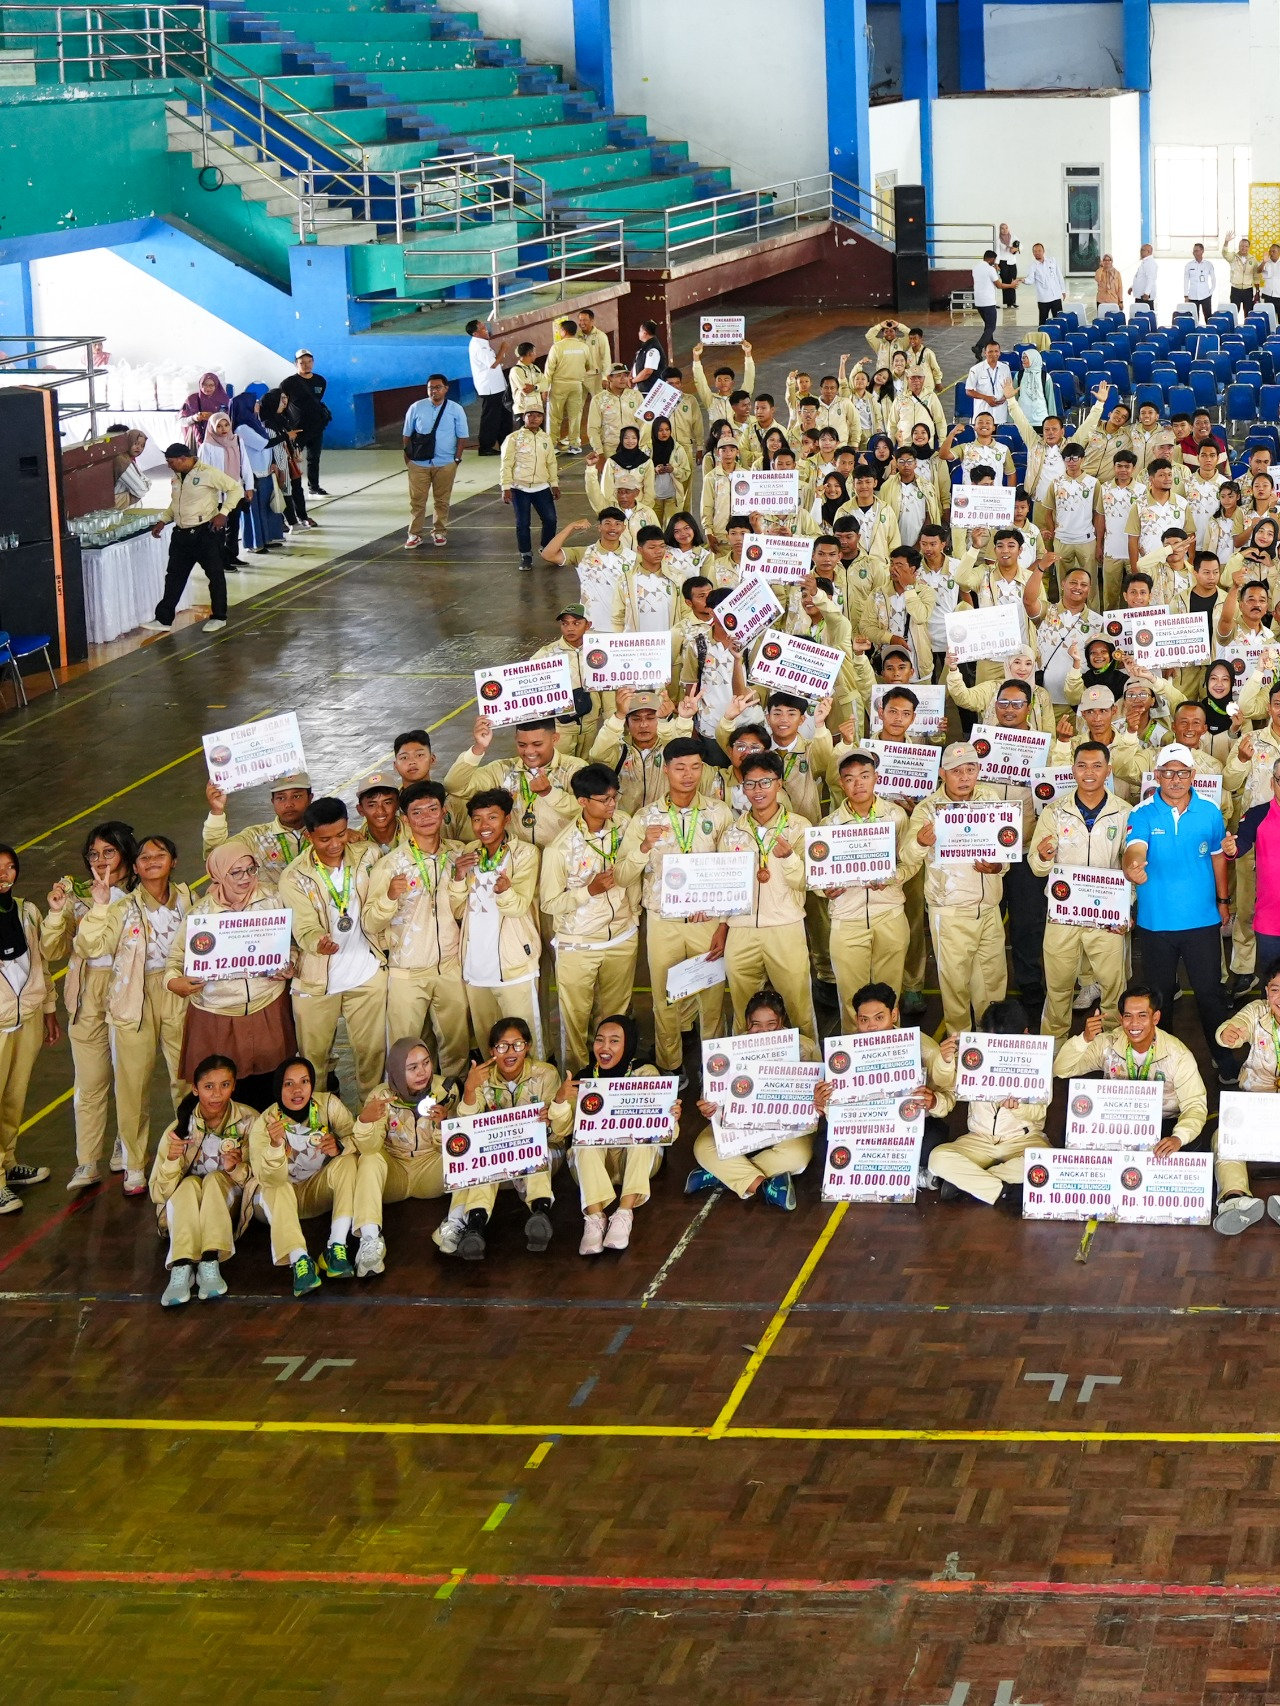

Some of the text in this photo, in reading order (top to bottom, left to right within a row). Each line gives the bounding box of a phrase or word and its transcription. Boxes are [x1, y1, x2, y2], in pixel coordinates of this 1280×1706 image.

[735, 497, 793, 506] Rp. 40.000.000
[766, 539, 809, 548] PENGHARGAAN
[503, 659, 563, 677] PENGHARGAAN
[484, 690, 568, 715] Rp. 30.000.000
[893, 759, 924, 767] PANAHAN
[832, 827, 890, 839] PENGHARGAAN
[857, 852, 888, 860] PERUNGGU
[810, 860, 891, 877] Rp. 10.000.000
[193, 954, 281, 971] Rp. 12.000.000
[853, 1032, 914, 1048] PENGHARGAAN
[988, 1039, 1048, 1049] PENGHARGAAN
[759, 1065, 819, 1076] PENGHARGAAN
[852, 1069, 915, 1087] 10.000.000
[961, 1074, 1045, 1089] Rp. 20.000.000
[609, 1080, 672, 1091] PENGHARGAAN
[1097, 1085, 1157, 1095] PENGHARGAAN
[730, 1103, 814, 1116] Rp. 10.000.000
[579, 1117, 669, 1131] Rp. 20.000.000
[1071, 1122, 1155, 1135] Rp. 20.000.000
[488, 1128, 524, 1141] JUJITSU
[483, 1138, 531, 1153] MEDALI PERAK
[449, 1145, 542, 1174] Rp. 20.000.000
[1053, 1154, 1113, 1165] PENGHARGAAN
[829, 1174, 910, 1186] Rp. 10.000.000
[1029, 1192, 1111, 1205] Rp. 10.000.000
[1122, 1194, 1205, 1208] Rp. 10.000.000
